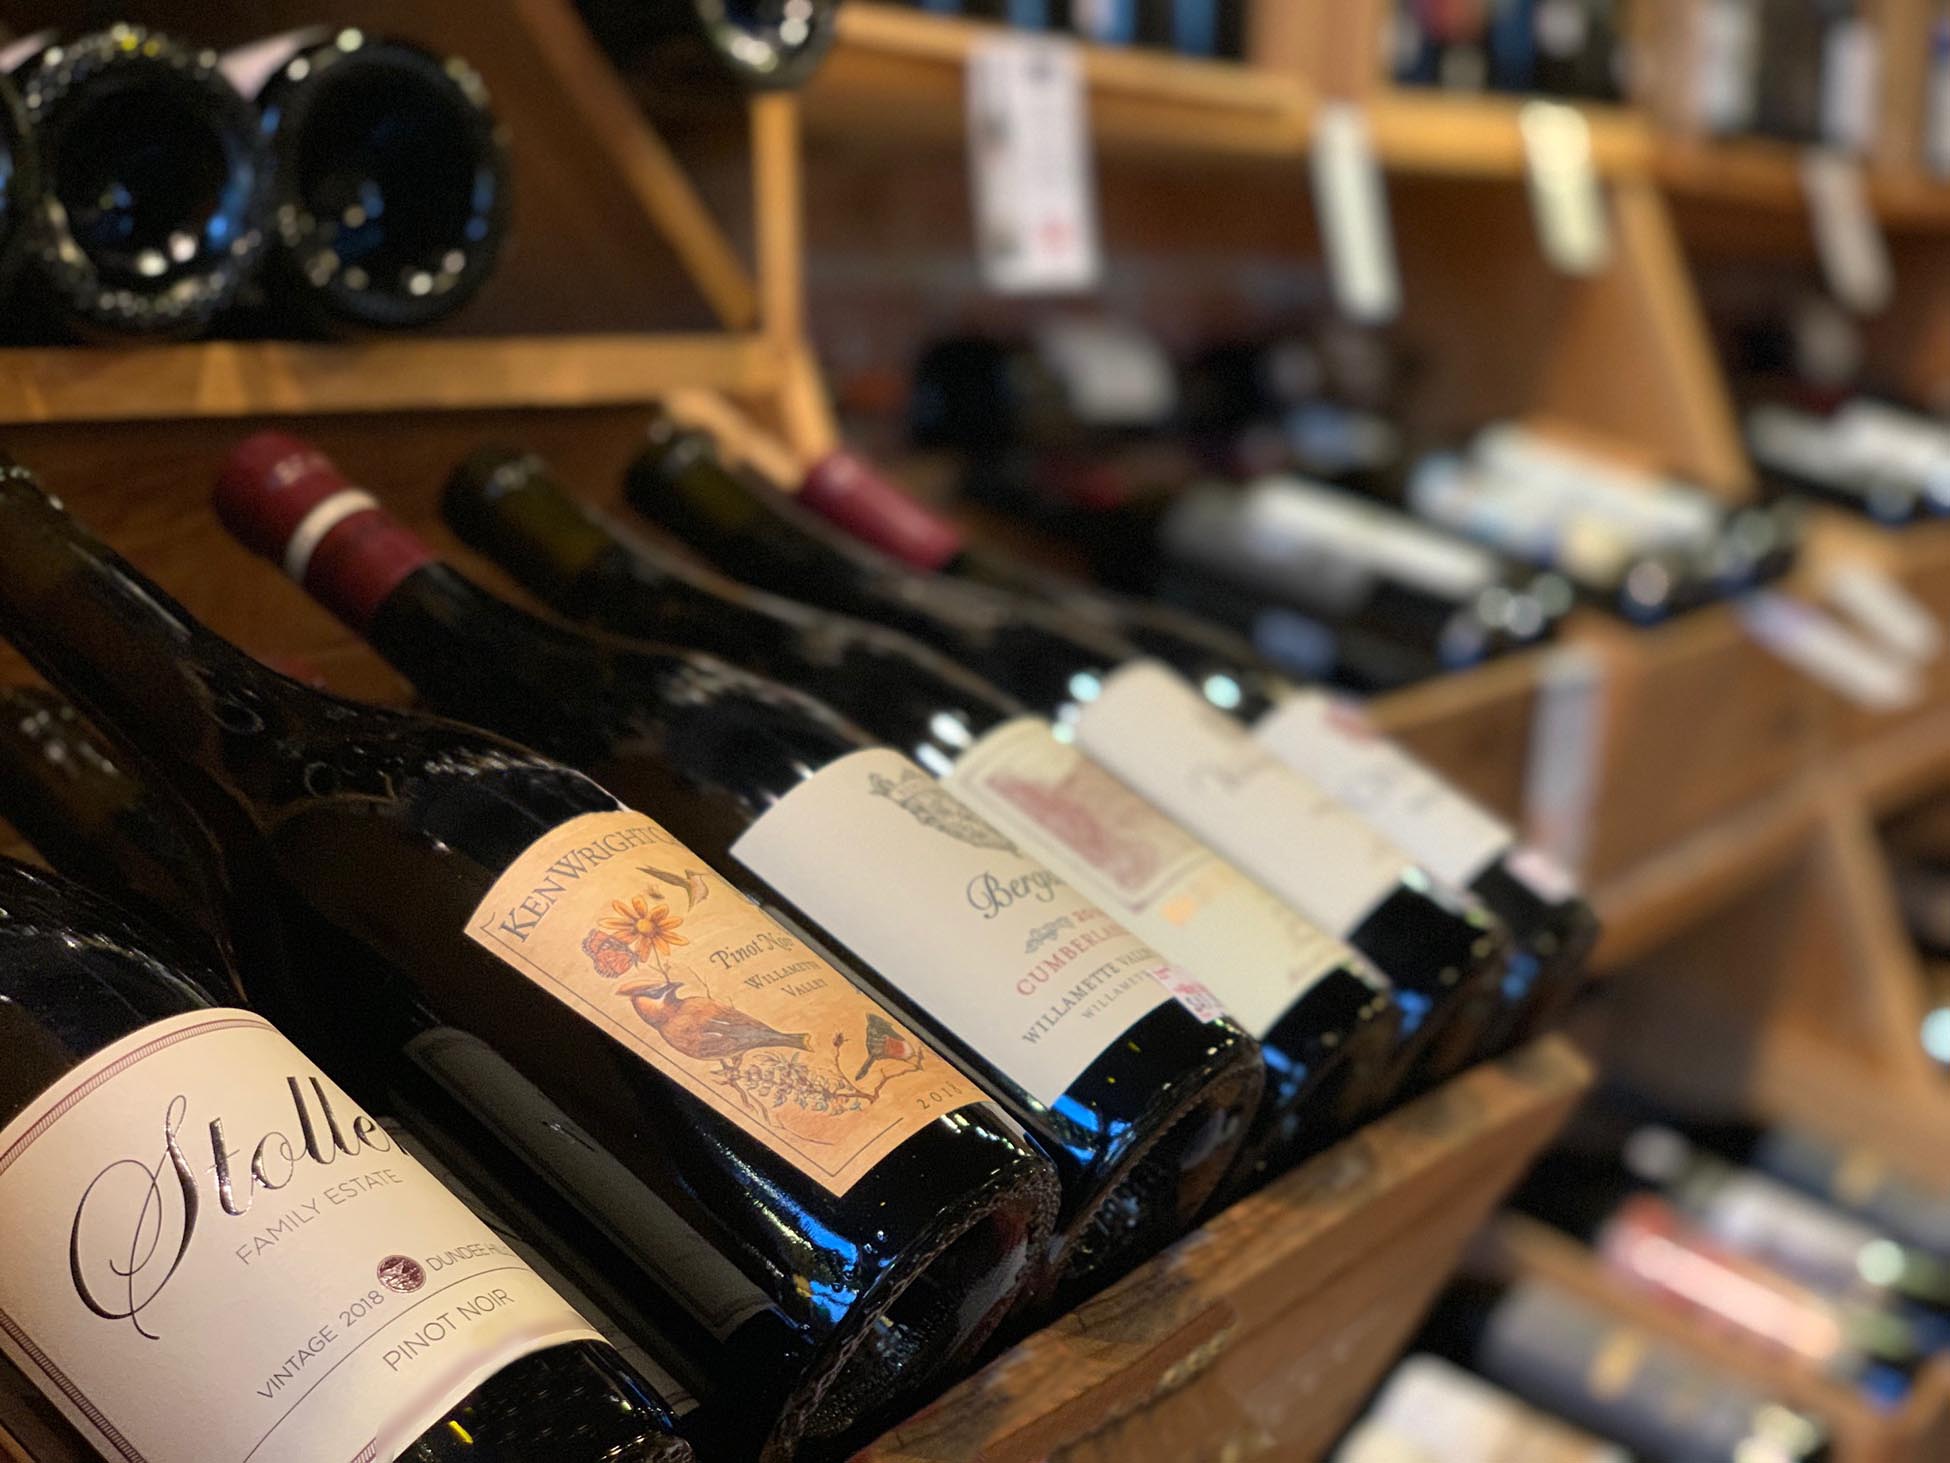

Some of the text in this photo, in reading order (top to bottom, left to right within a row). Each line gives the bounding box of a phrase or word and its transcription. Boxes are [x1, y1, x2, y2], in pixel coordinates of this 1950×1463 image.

[500, 876, 557, 943] KEN
[709, 937, 764, 970] Pinot
[1016, 923, 1130, 996] CUMBERLA
[1022, 963, 1121, 1045] WILLAMETTE
[1081, 969, 1152, 1020] WILLAMET
[69, 1076, 409, 1340] Stolle
[235, 1168, 404, 1265] FAMILY ESTATE
[425, 1243, 491, 1272] DUNDEE
[256, 1289, 386, 1400] VINTAGE 2018
[382, 1288, 516, 1372] PINOT NOIR
